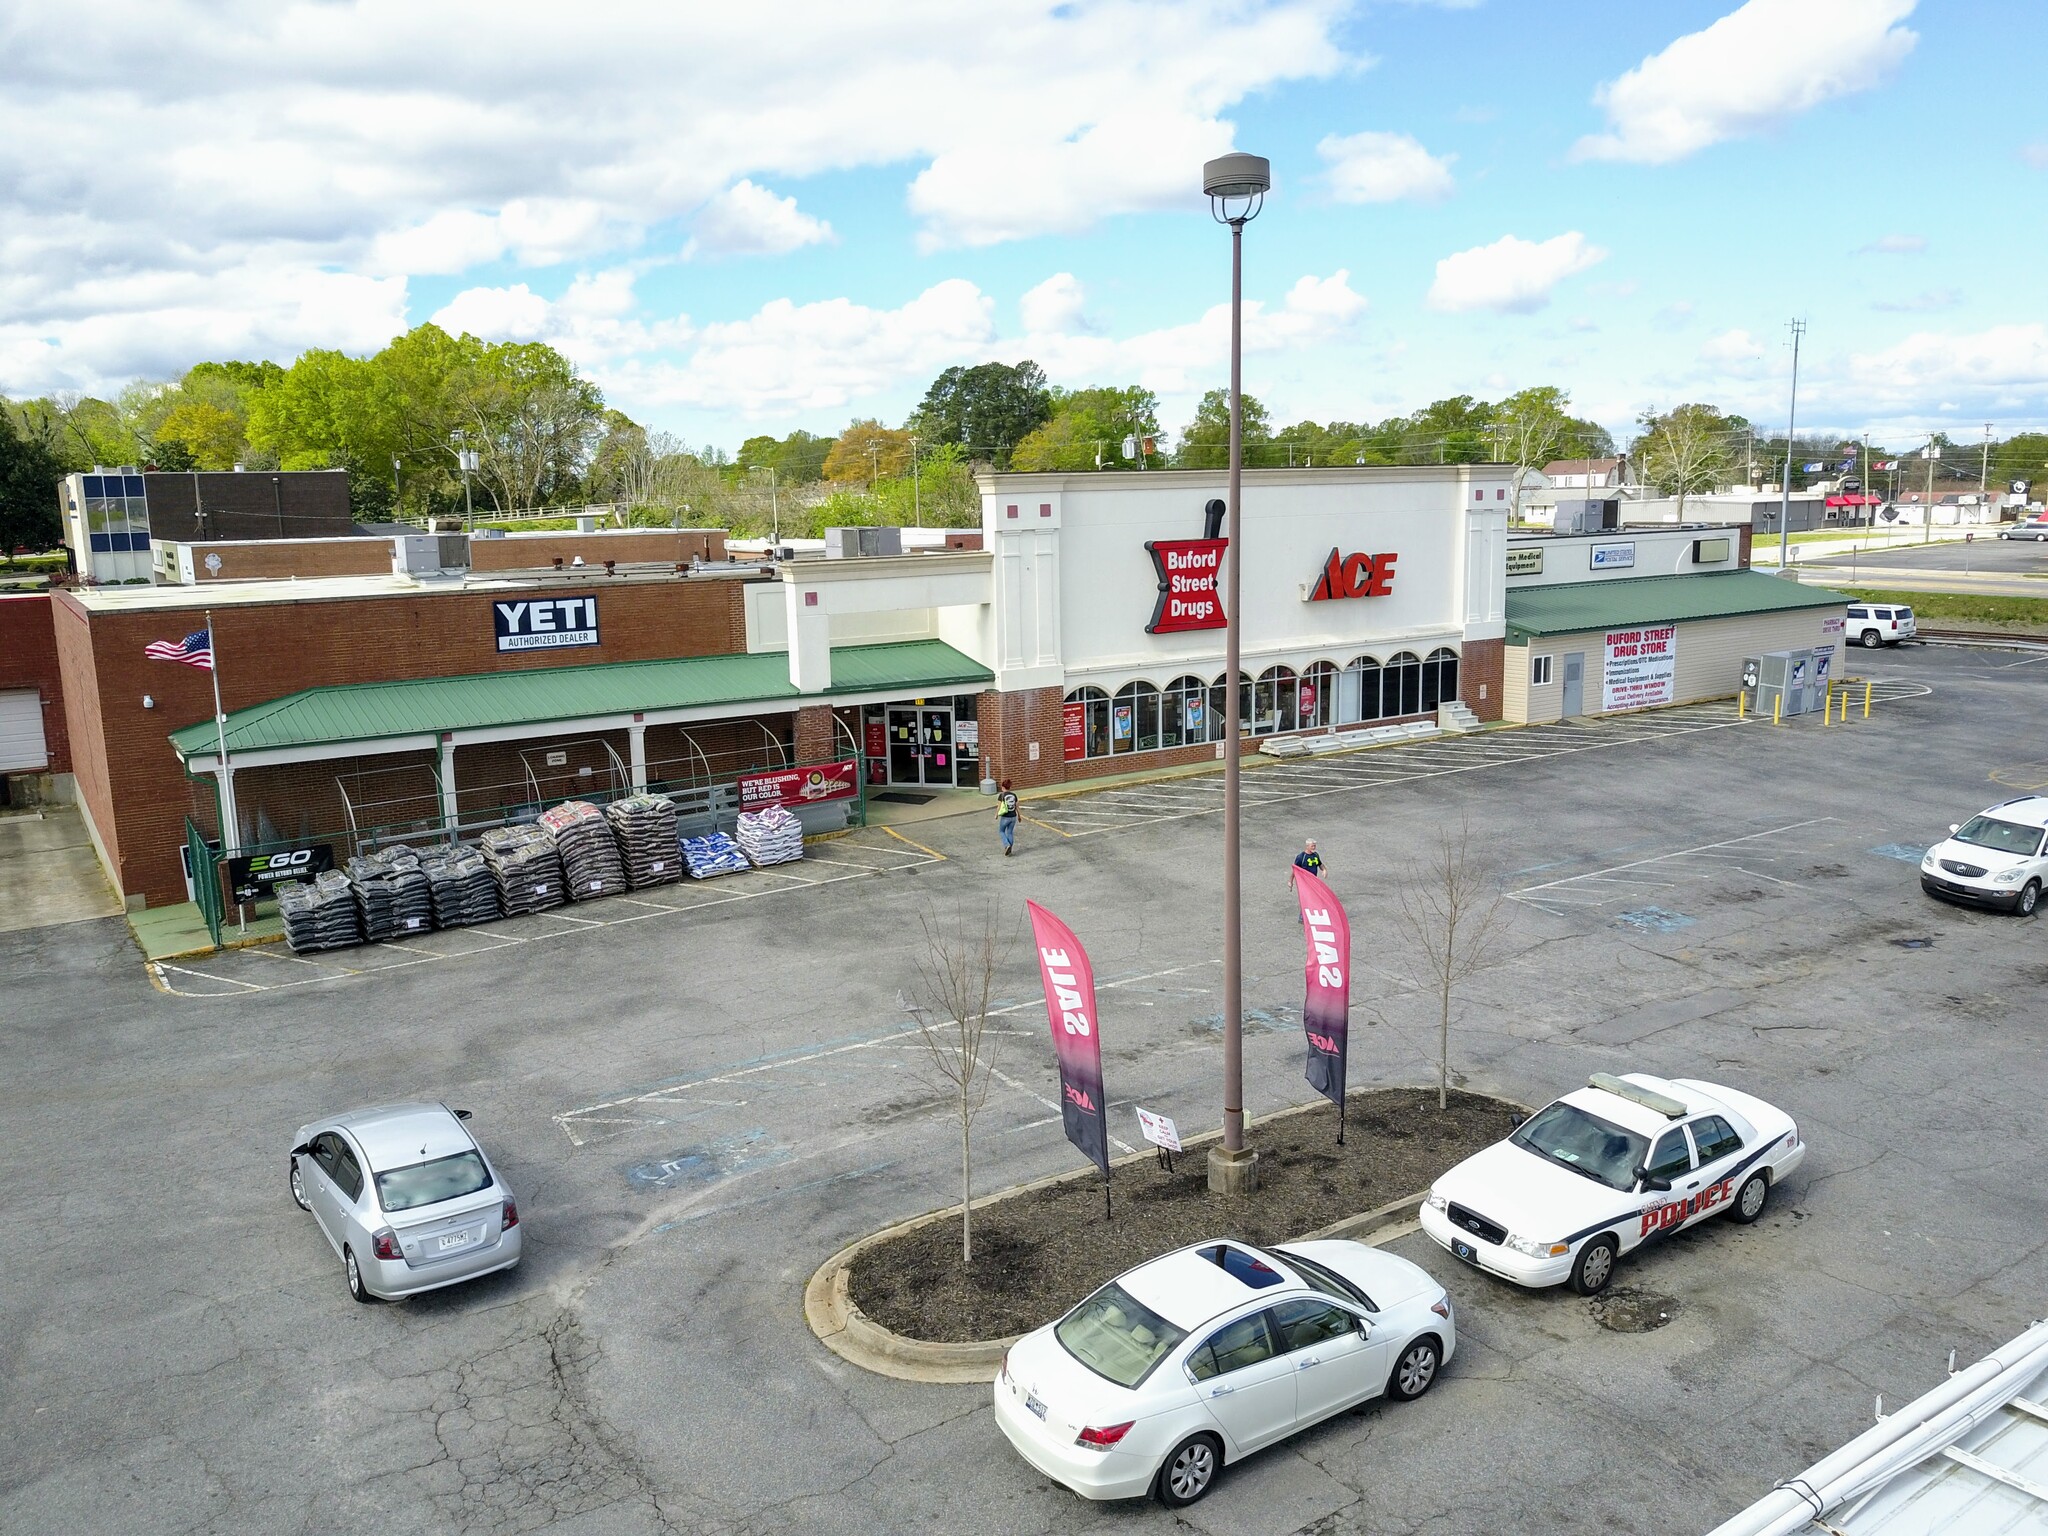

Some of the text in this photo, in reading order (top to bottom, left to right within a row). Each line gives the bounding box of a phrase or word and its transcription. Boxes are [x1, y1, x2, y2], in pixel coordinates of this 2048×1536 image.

[1167, 550, 1216, 570] Buford
[1518, 552, 1541, 561] Medical
[1309, 547, 1398, 601] ACE
[1172, 574, 1213, 593] Street
[496, 598, 596, 633] YETI
[1171, 600, 1213, 619] Drugs
[508, 633, 589, 647] AUTHORIZED DEALER
[1607, 628, 1675, 645] BUFORD STREET
[1614, 642, 1667, 658] DRUG STORE
[1609, 667, 1640, 676] Immunizations
[1628, 675, 1649, 684] Equipment
[1654, 672, 1672, 680] Supplies
[1627, 692, 1644, 700] Delivery
[742, 774, 800, 787] WE'RE BLUSHING,
[742, 792, 758, 801] OUR
[249, 850, 311, 871] EGO
[258, 872, 274, 880] POWER
[1640, 1176, 1736, 1238] POLICE
